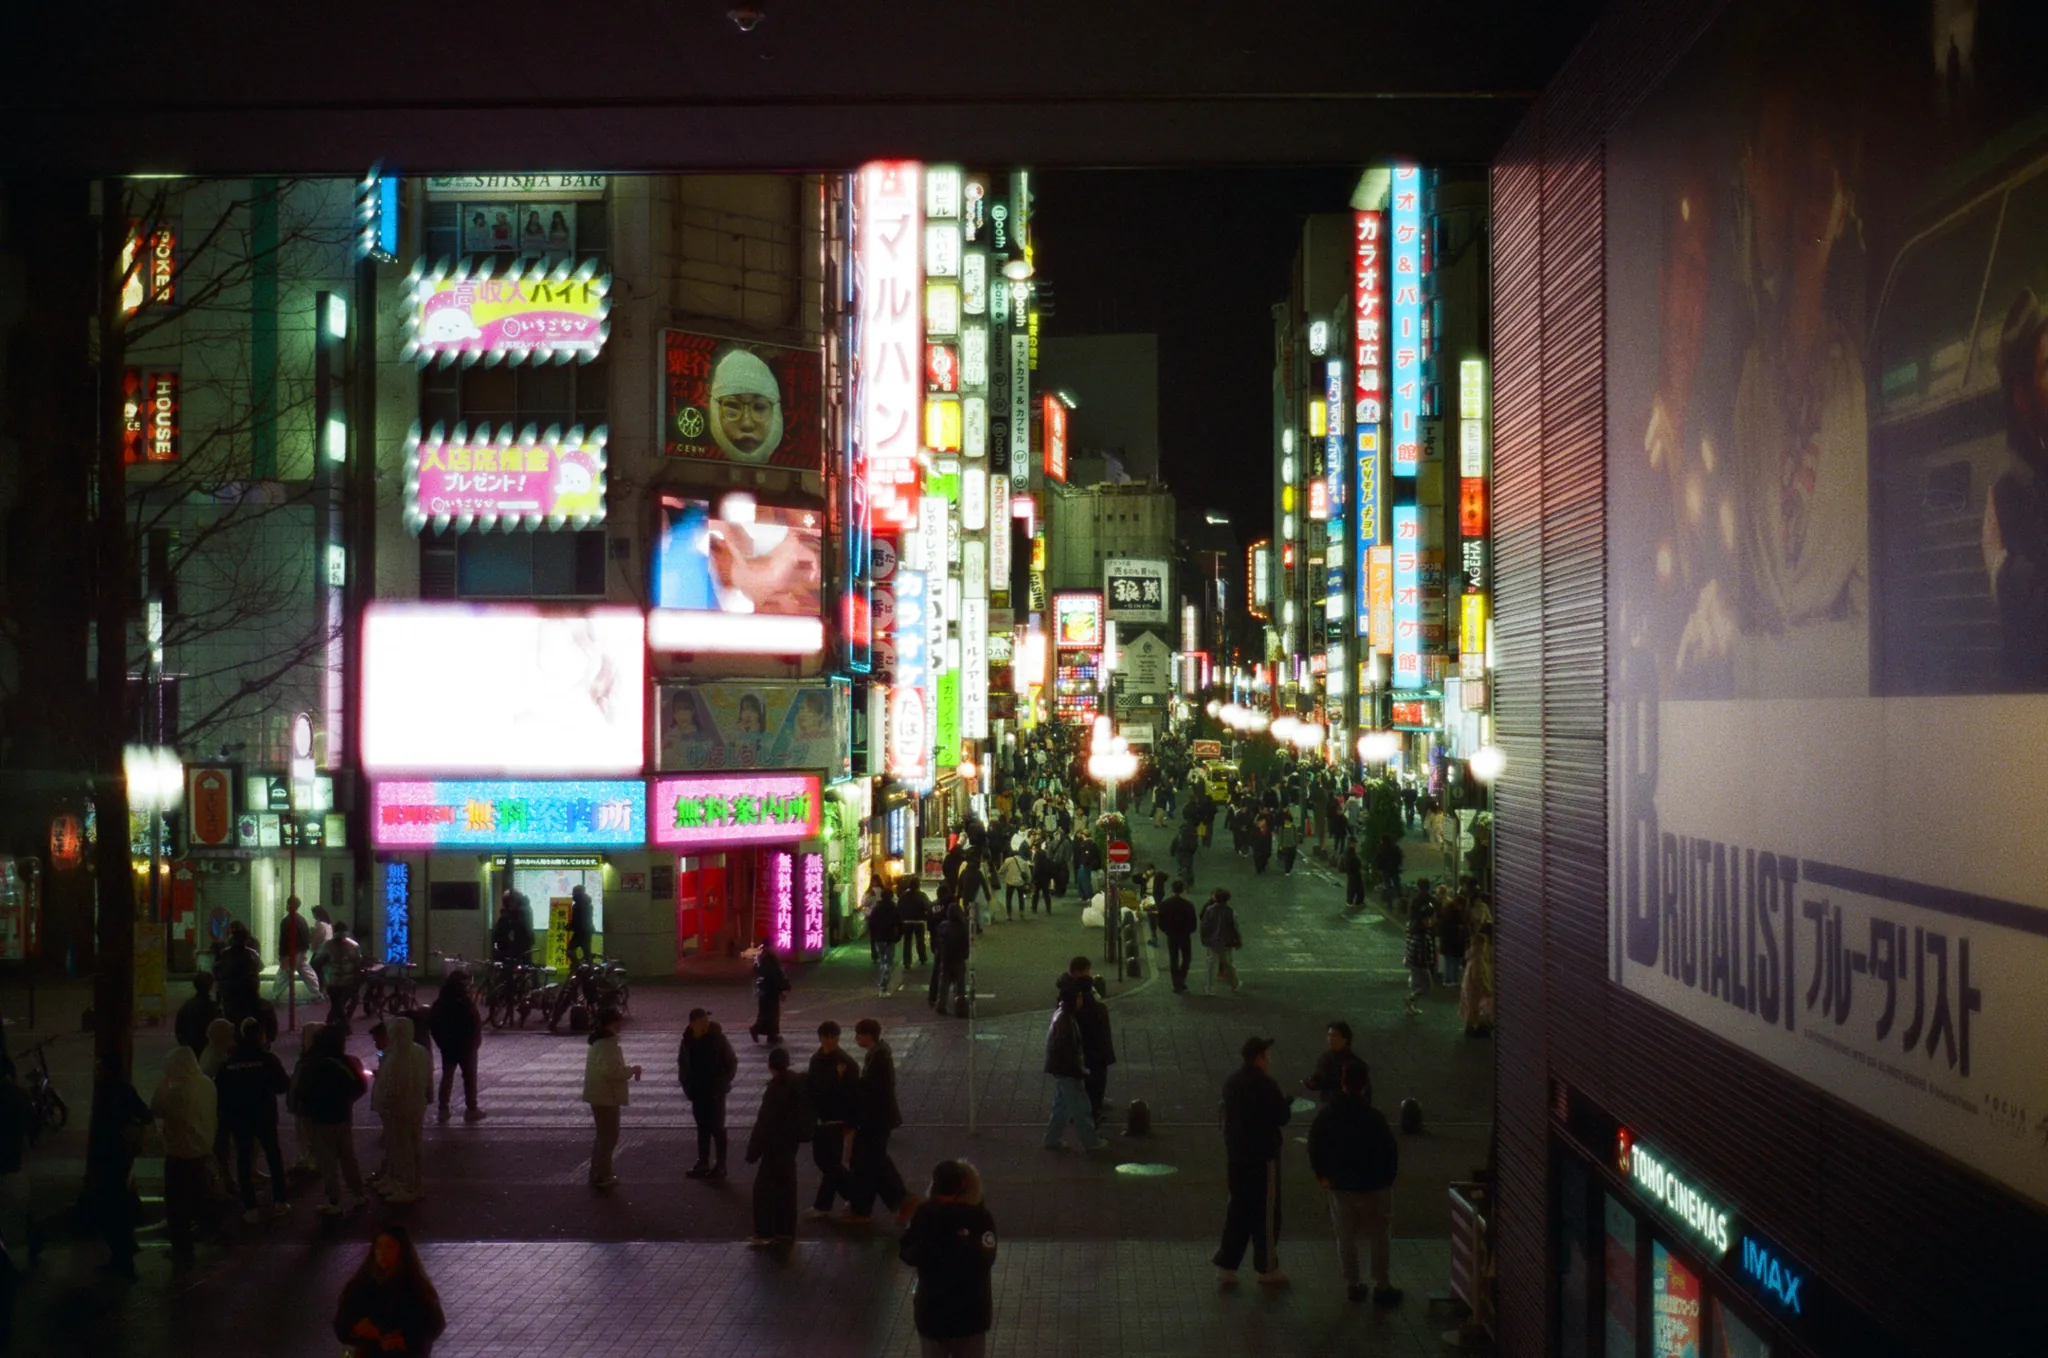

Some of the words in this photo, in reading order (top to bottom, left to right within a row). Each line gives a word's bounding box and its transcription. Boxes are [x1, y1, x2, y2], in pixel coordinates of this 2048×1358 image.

[155, 228, 172, 303] POKER
[1357, 217, 1380, 391] カラオケ歌広場
[873, 213, 912, 448] マルハン
[156, 380, 172, 454] HOUSE
[1030, 573, 1044, 609] CASINO
[1399, 521, 1418, 672] カラオケ館
[1469, 540, 1482, 587] AGEHA
[464, 798, 631, 832] 無料案内所
[674, 792, 812, 829] 無料案内所
[387, 863, 409, 964] 無料案内所
[777, 852, 792, 949] 無料案内所
[804, 852, 824, 949] 無料案内所
[1803, 899, 1981, 1078] ブルータリスト
[1631, 1144, 1665, 1199] TOHO
[1666, 1172, 1728, 1252] CINEMAS
[1743, 1236, 1801, 1313] IMAX
